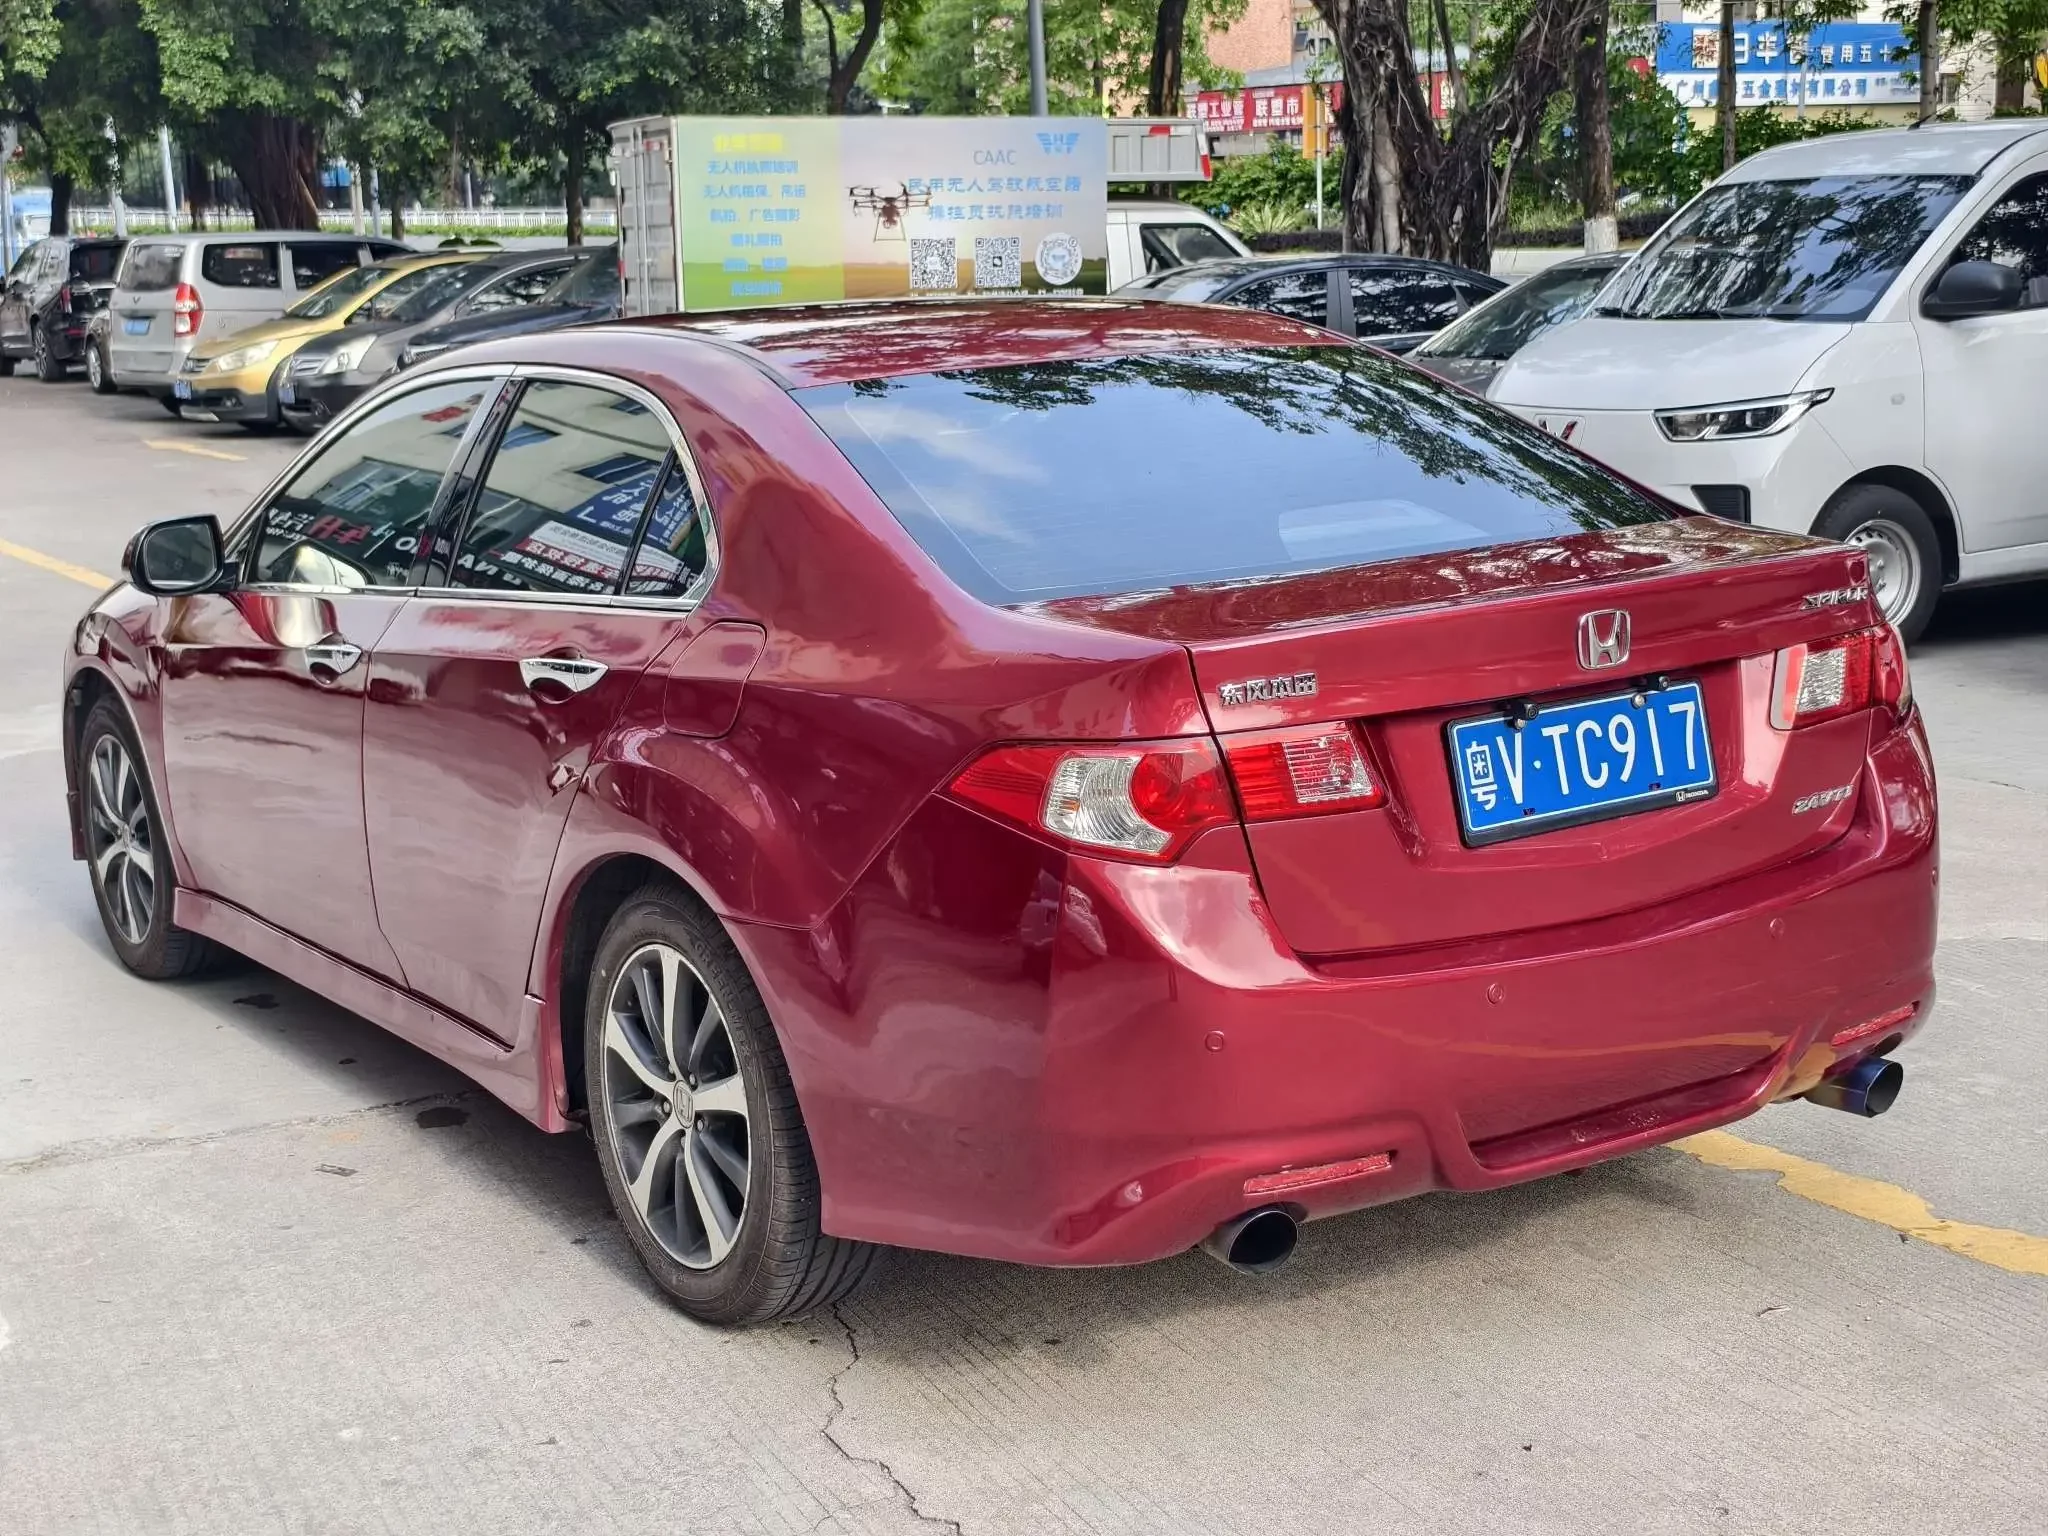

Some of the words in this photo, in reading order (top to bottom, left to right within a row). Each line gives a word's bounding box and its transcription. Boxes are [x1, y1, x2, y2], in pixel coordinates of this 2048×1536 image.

[973, 151, 1017, 166] CAAC
[1219, 672, 1317, 706] 东风本田
